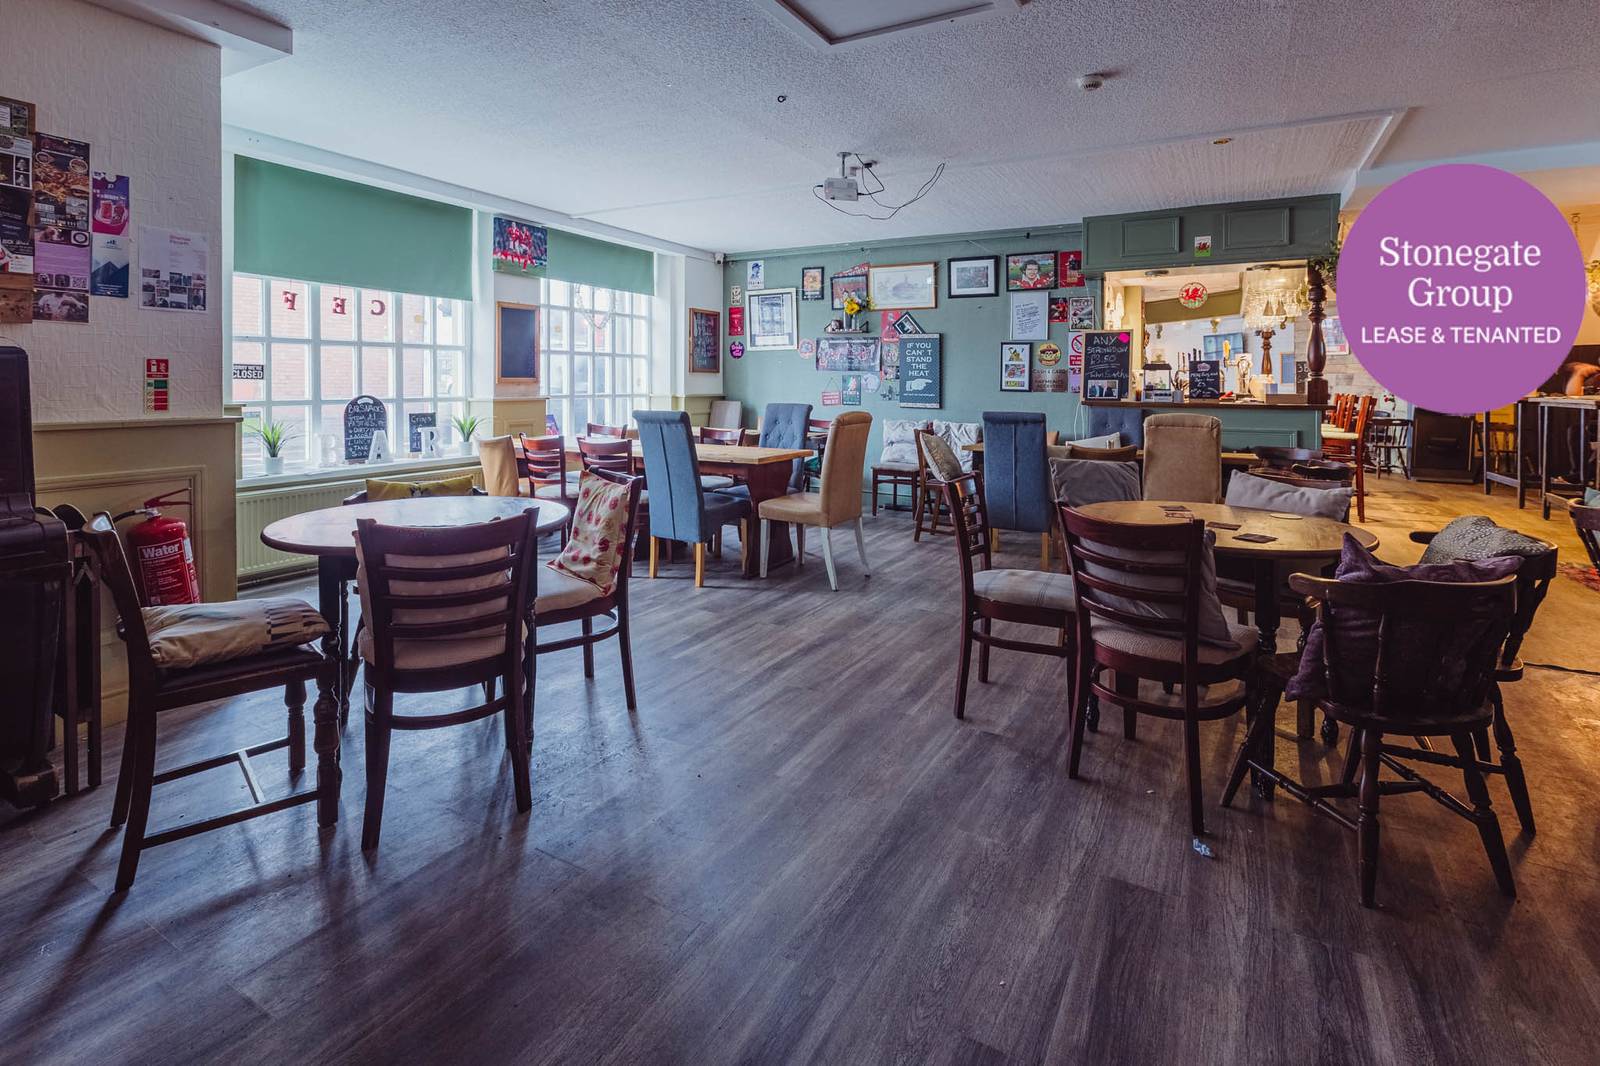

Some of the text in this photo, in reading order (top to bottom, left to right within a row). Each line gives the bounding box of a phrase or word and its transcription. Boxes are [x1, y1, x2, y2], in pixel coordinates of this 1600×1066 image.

[1093, 335, 1118, 345] ANY
[232, 370, 263, 379] CLOSED
[142, 543, 180, 558] Water
